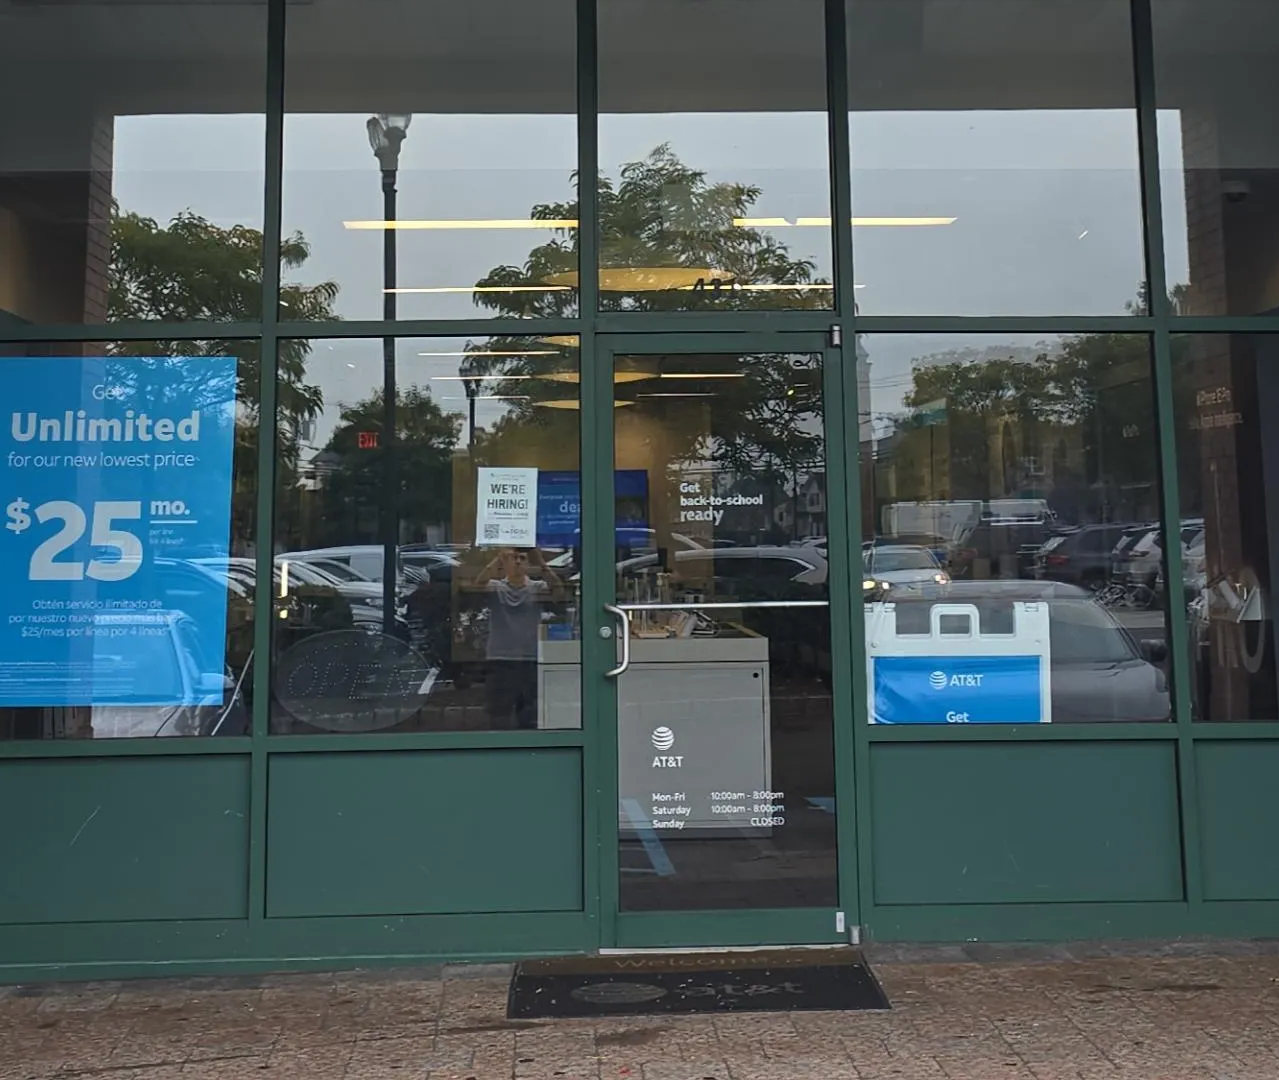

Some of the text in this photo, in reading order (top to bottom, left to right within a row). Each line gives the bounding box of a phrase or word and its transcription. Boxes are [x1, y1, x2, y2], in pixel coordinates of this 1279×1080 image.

[92, 384, 126, 400] Get
[11, 409, 200, 442] Unlimited
[8, 451, 31, 467] for
[33, 454, 60, 467] our
[63, 454, 97, 467] new
[100, 452, 151, 467] lowest
[680, 482, 701, 493] Get
[487, 498, 529, 510] HIRING!
[680, 494, 763, 506] back-to-school
[680, 506, 724, 526] ready
[5, 497, 191, 582] $25 mo.
[149, 599, 163, 609] de
[8, 614, 25, 624] por
[949, 674, 984, 687] AT&T
[946, 711, 970, 723] Get
[652, 756, 684, 768] AT&T
[652, 792, 686, 802] Mon-Fri
[710, 791, 745, 800] 10:00am
[752, 790, 784, 801] 8:00pm
[652, 805, 692, 817] Saturday
[711, 804, 746, 814] 10:00am
[753, 804, 785, 814] 8:00pm
[652, 817, 785, 830] Sunday CLOSED
